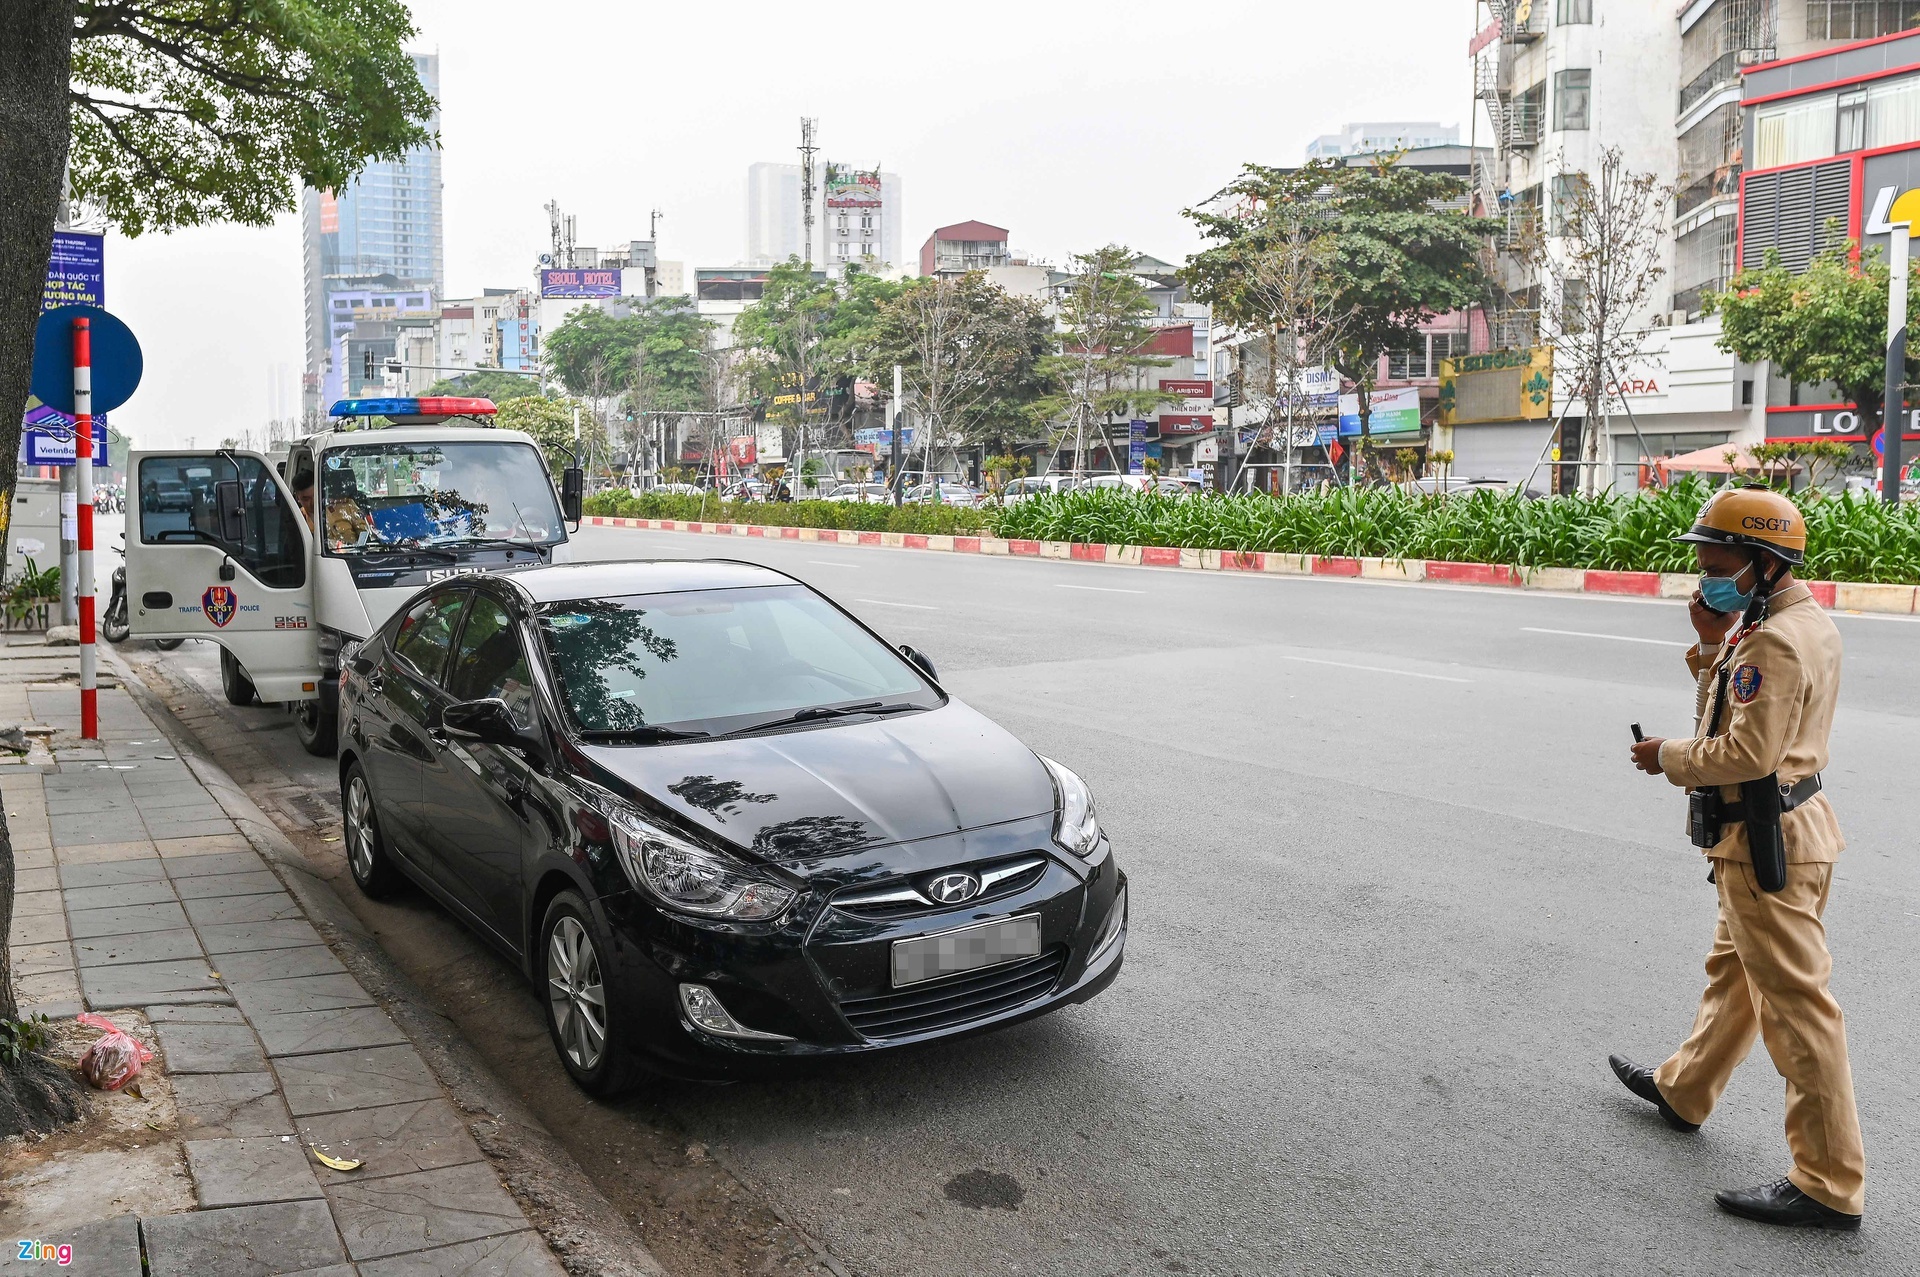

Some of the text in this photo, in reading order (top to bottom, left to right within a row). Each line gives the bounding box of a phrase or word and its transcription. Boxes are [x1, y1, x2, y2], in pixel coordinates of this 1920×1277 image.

[67, 272, 89, 280] QUỐC
[548, 272, 615, 285] SEOUL HOTEL
[66, 281, 85, 290] TÁC
[77, 293, 96, 303] MẠI
[774, 395, 796, 405] COFFEE
[40, 446, 76, 455] VietinBa
[1741, 516, 1791, 533] CSGT
